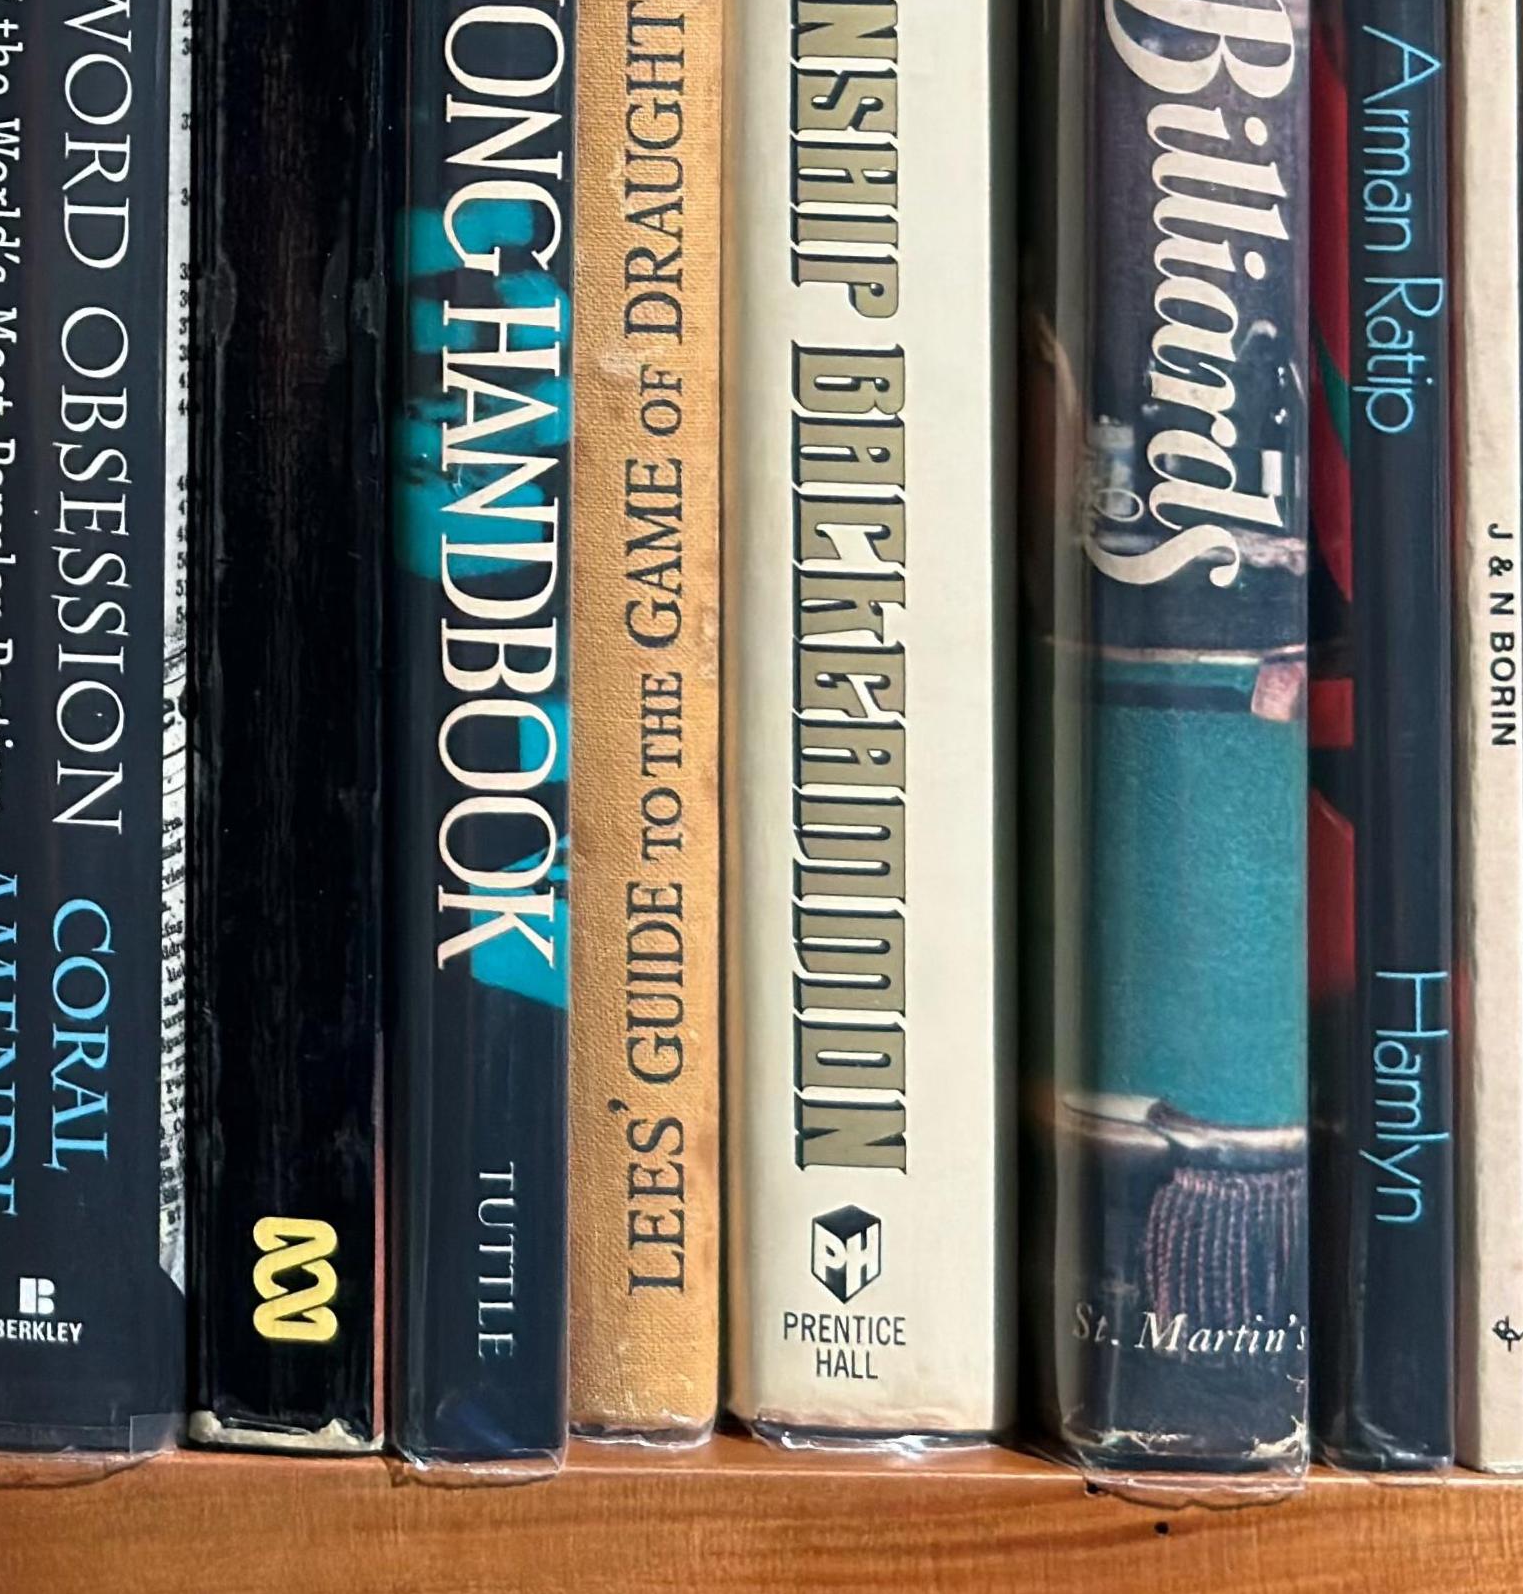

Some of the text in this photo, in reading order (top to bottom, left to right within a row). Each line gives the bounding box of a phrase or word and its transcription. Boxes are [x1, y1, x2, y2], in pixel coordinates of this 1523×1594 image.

[1352, 24, 1444, 434] Arman Ratip
[640, 363, 682, 437] OF
[51, 307, 132, 835] OBSESSION
[436, 300, 561, 970] HANDBOOK
[624, 457, 683, 650] GAME
[640, 670, 683, 778] THE
[791, 339, 907, 1175] BACKGAMMON
[639, 784, 683, 864] TO
[43, 898, 115, 1171] CORAL
[626, 881, 684, 1085] GUIDE
[608, 1098, 685, 1295] LEES'
[1359, 971, 1450, 1225] Hamlyn
[478, 1161, 516, 1358] TUTTLE
[783, 1312, 906, 1346] PRENTICE
[816, 1348, 878, 1379] HALL
